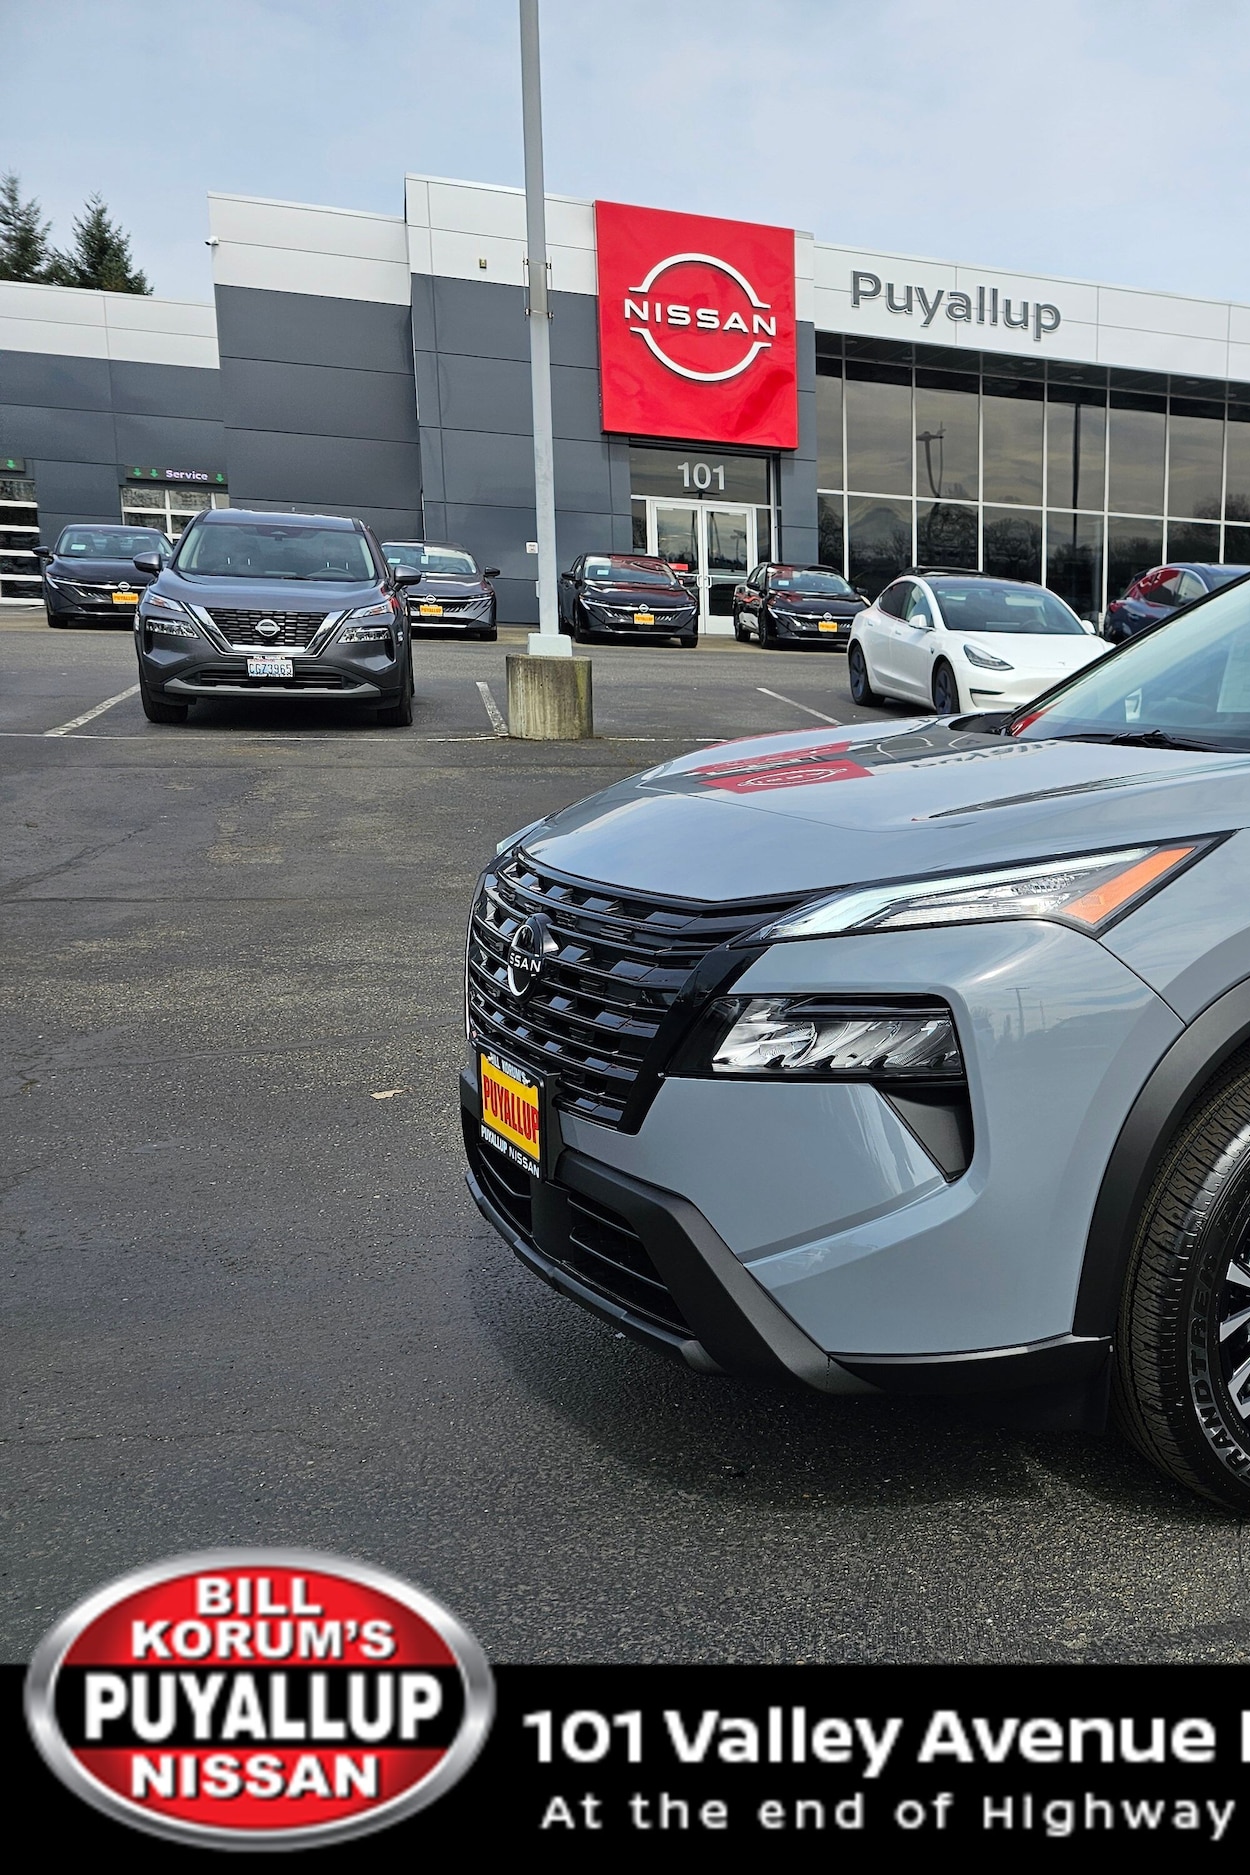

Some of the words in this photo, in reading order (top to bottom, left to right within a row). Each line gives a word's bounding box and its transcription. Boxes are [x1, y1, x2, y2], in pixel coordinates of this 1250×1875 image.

[624, 299, 777, 337] NISSAN
[851, 270, 1061, 341] Puyallup
[165, 469, 209, 481] Service
[677, 461, 725, 490] 101
[509, 952, 541, 973] SSAN
[483, 1074, 540, 1145] PUYALLUP
[481, 1125, 508, 1153] PUYALLUP
[508, 1145, 540, 1179] NISSAN
